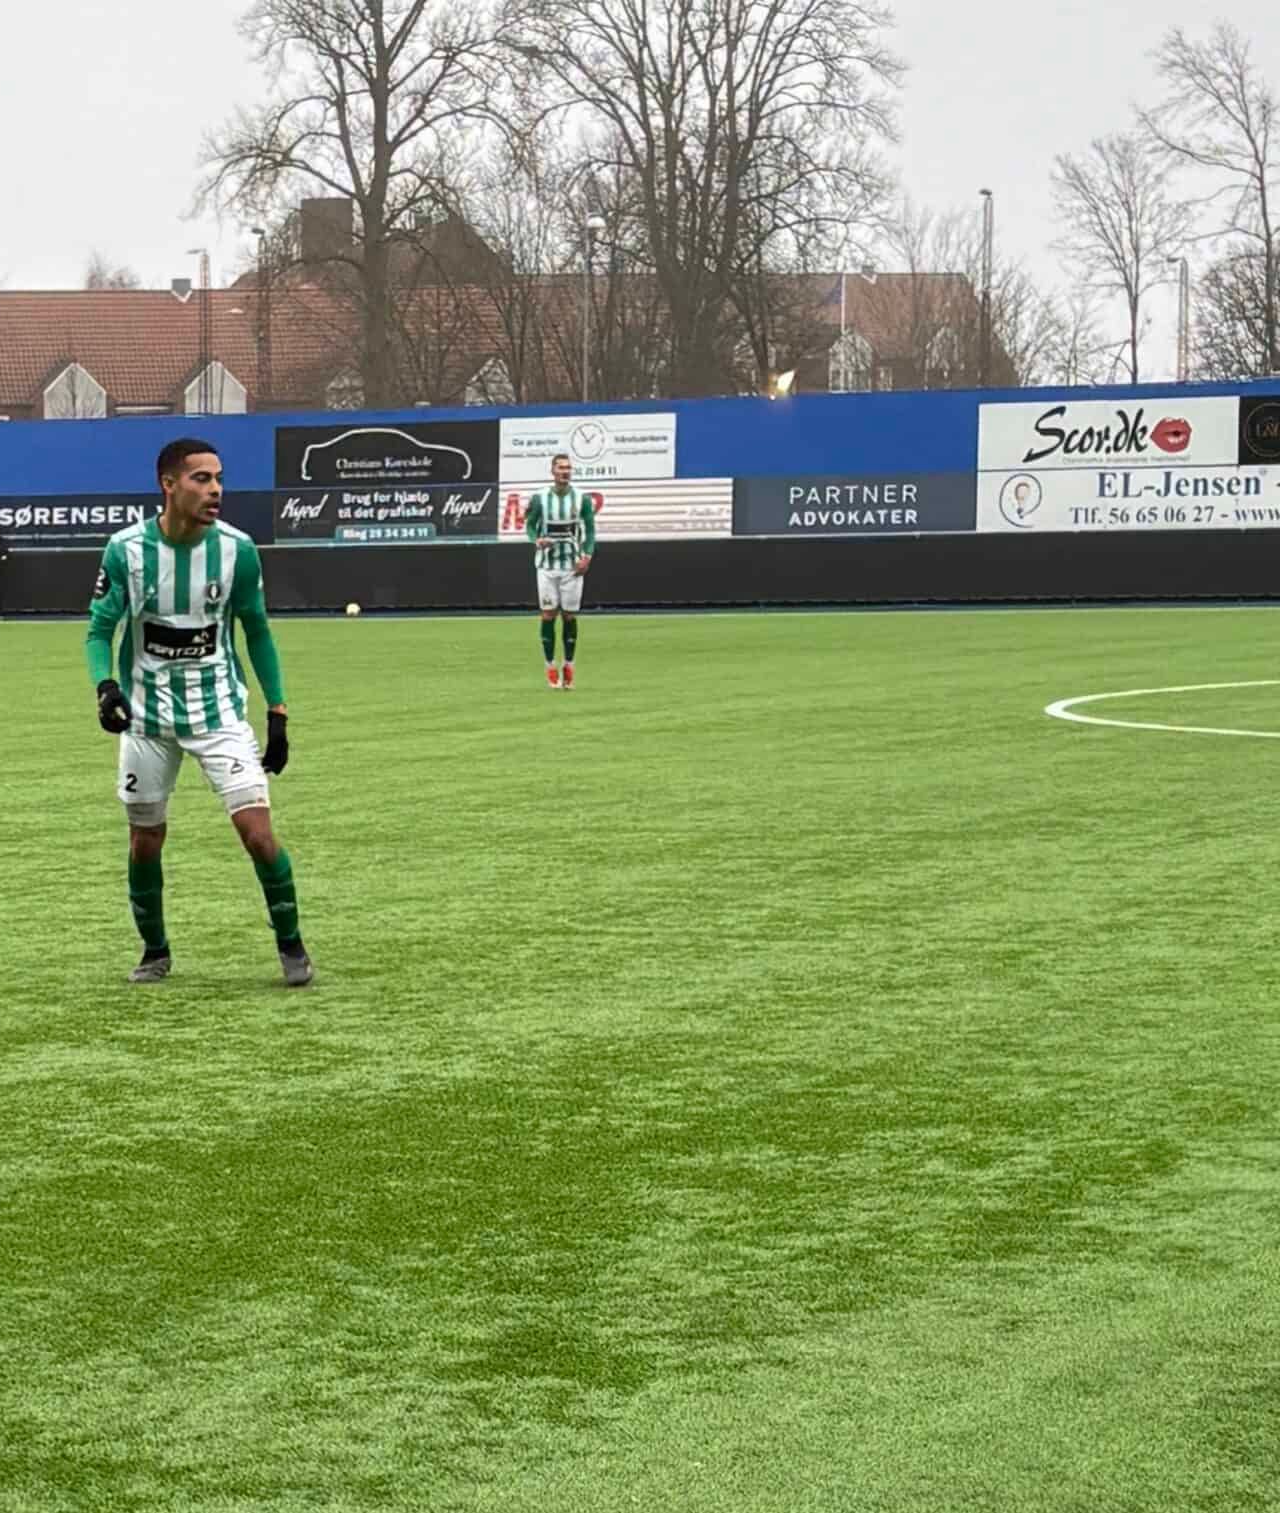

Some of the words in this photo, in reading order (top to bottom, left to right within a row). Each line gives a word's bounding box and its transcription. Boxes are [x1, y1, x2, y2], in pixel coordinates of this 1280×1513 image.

[1022, 405, 1148, 463] Scor.dk
[373, 491, 392, 503] for
[789, 484, 918, 505] PARTNER
[788, 509, 918, 526] ADVOKATER
[1070, 506, 1102, 525] Tlf.
[1108, 507, 1130, 524] 56
[1136, 506, 1158, 524] 65
[1164, 506, 1186, 523] 06
[1192, 505, 1214, 523] 27
[125, 773, 138, 793] 2
